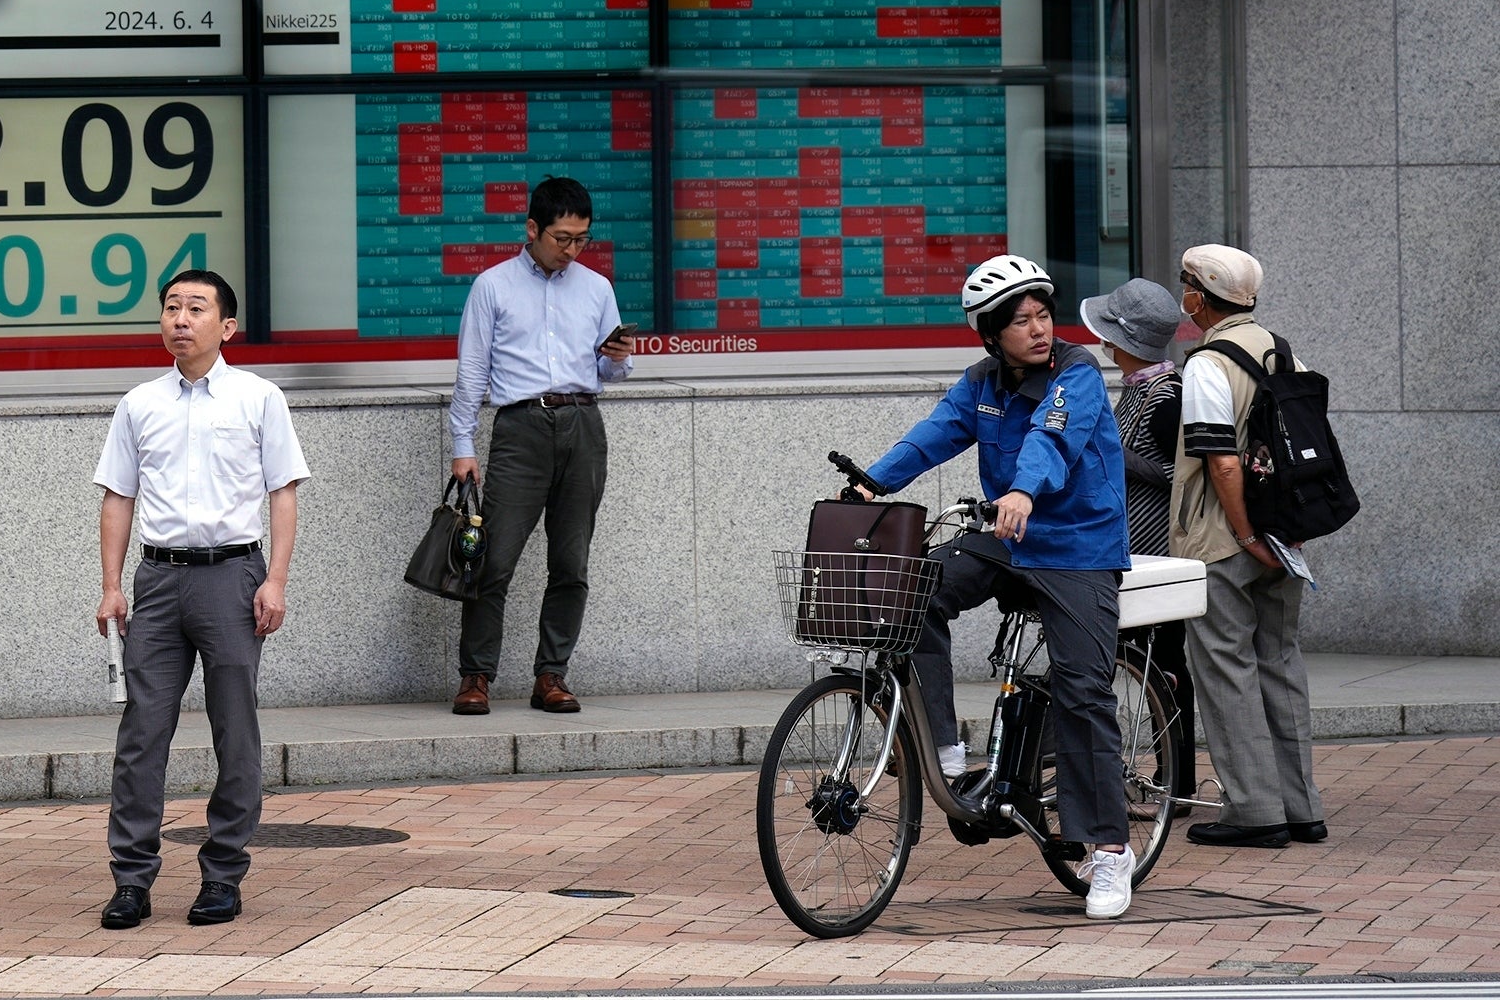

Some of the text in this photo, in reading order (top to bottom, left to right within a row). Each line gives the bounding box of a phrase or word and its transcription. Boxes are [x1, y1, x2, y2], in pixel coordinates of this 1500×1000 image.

[265, 13, 338, 30] Nikkei225
[631, 334, 758, 354] ITO Securities
